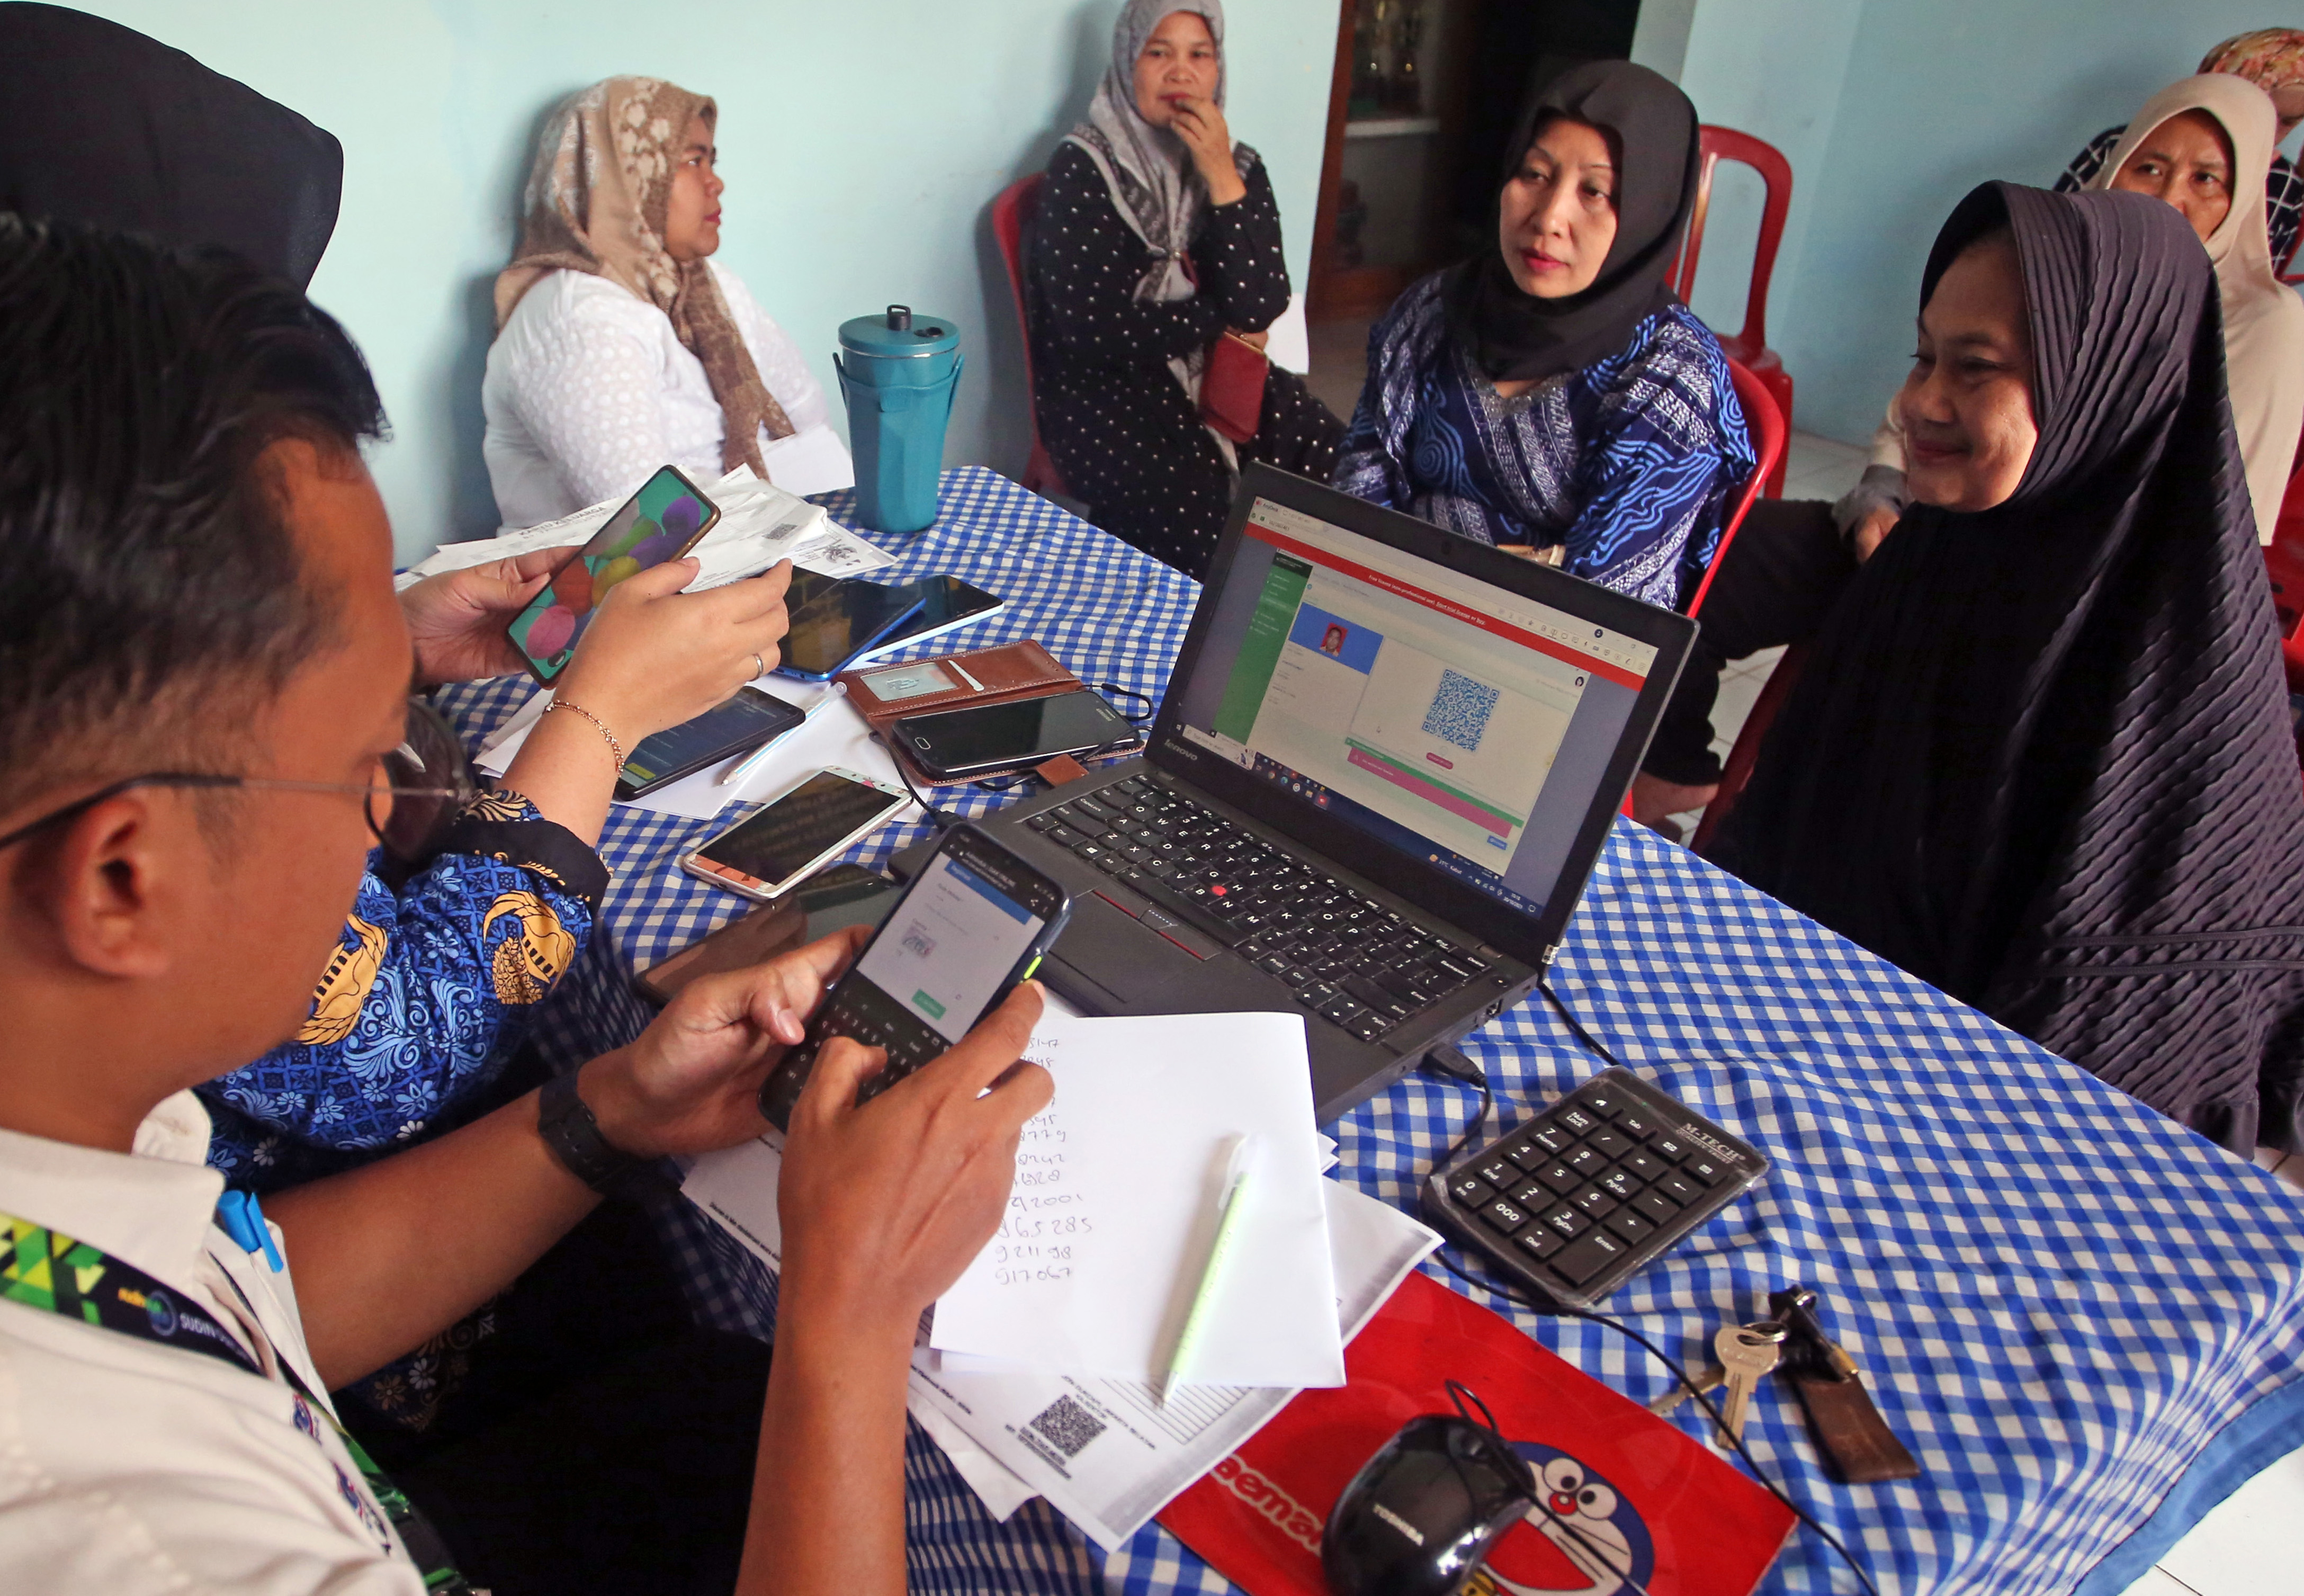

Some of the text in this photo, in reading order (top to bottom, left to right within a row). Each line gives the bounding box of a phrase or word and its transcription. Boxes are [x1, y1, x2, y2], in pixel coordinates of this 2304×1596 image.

[554, 506, 607, 525] KELUARGA
[1566, 1116, 1582, 1128] Lock
[1571, 1112, 1589, 1125] Num
[1628, 1119, 1642, 1129] Tab
[1536, 1133, 1557, 1149] Home
[1483, 1168, 1499, 1180] End
[1554, 1168, 1565, 1177] 5
[1527, 1187, 1538, 1196] 2
[1606, 1179, 1626, 1194] PgUp
[1495, 1203, 1520, 1221] 000
[1553, 1216, 1573, 1232] PgDn
[1525, 1235, 1541, 1247] Del
[1594, 1235, 1616, 1251] Enter
[1373, 1503, 1424, 1547] TOSHIBA
